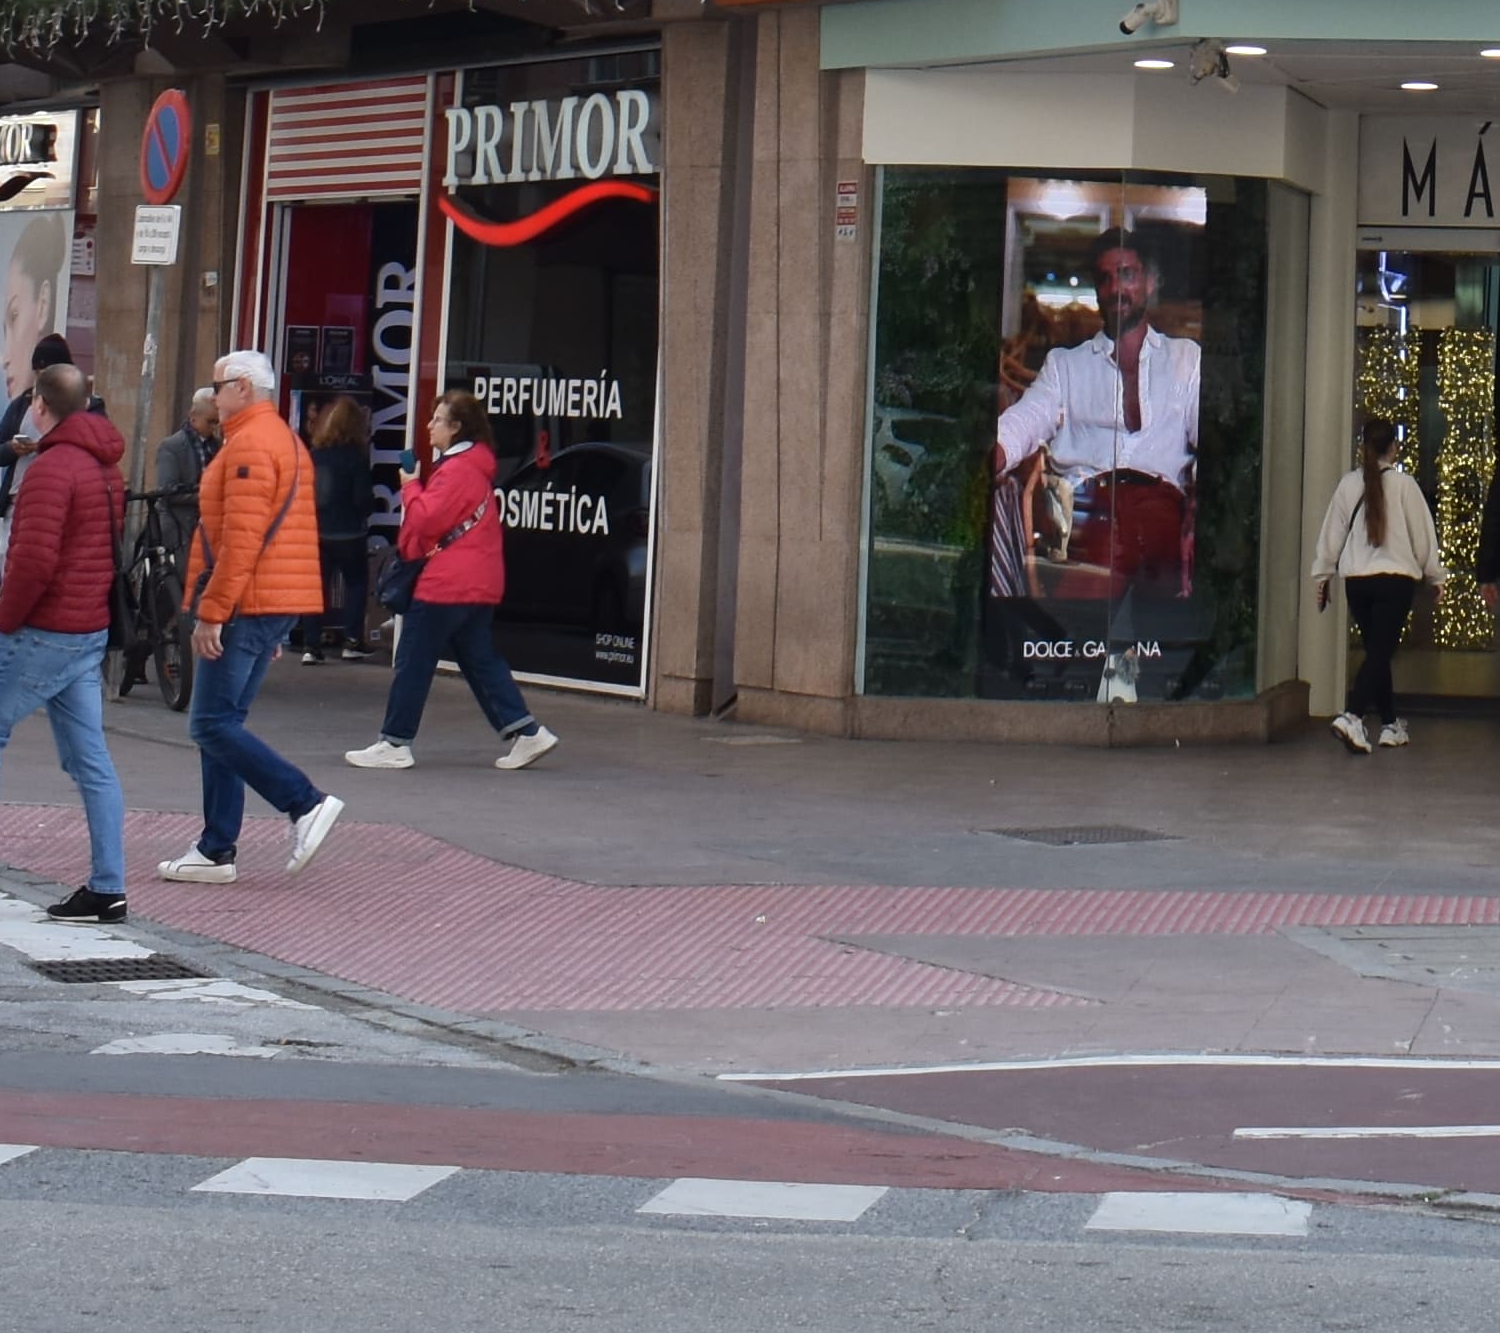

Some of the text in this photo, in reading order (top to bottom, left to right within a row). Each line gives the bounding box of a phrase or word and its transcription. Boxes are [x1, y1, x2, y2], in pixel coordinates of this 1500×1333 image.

[442, 90, 653, 186] PRIMOR
[474, 369, 622, 419] PERFUMERÍA
[1023, 641, 1073, 658] DOLCE
[1083, 641, 1162, 658] GANA
